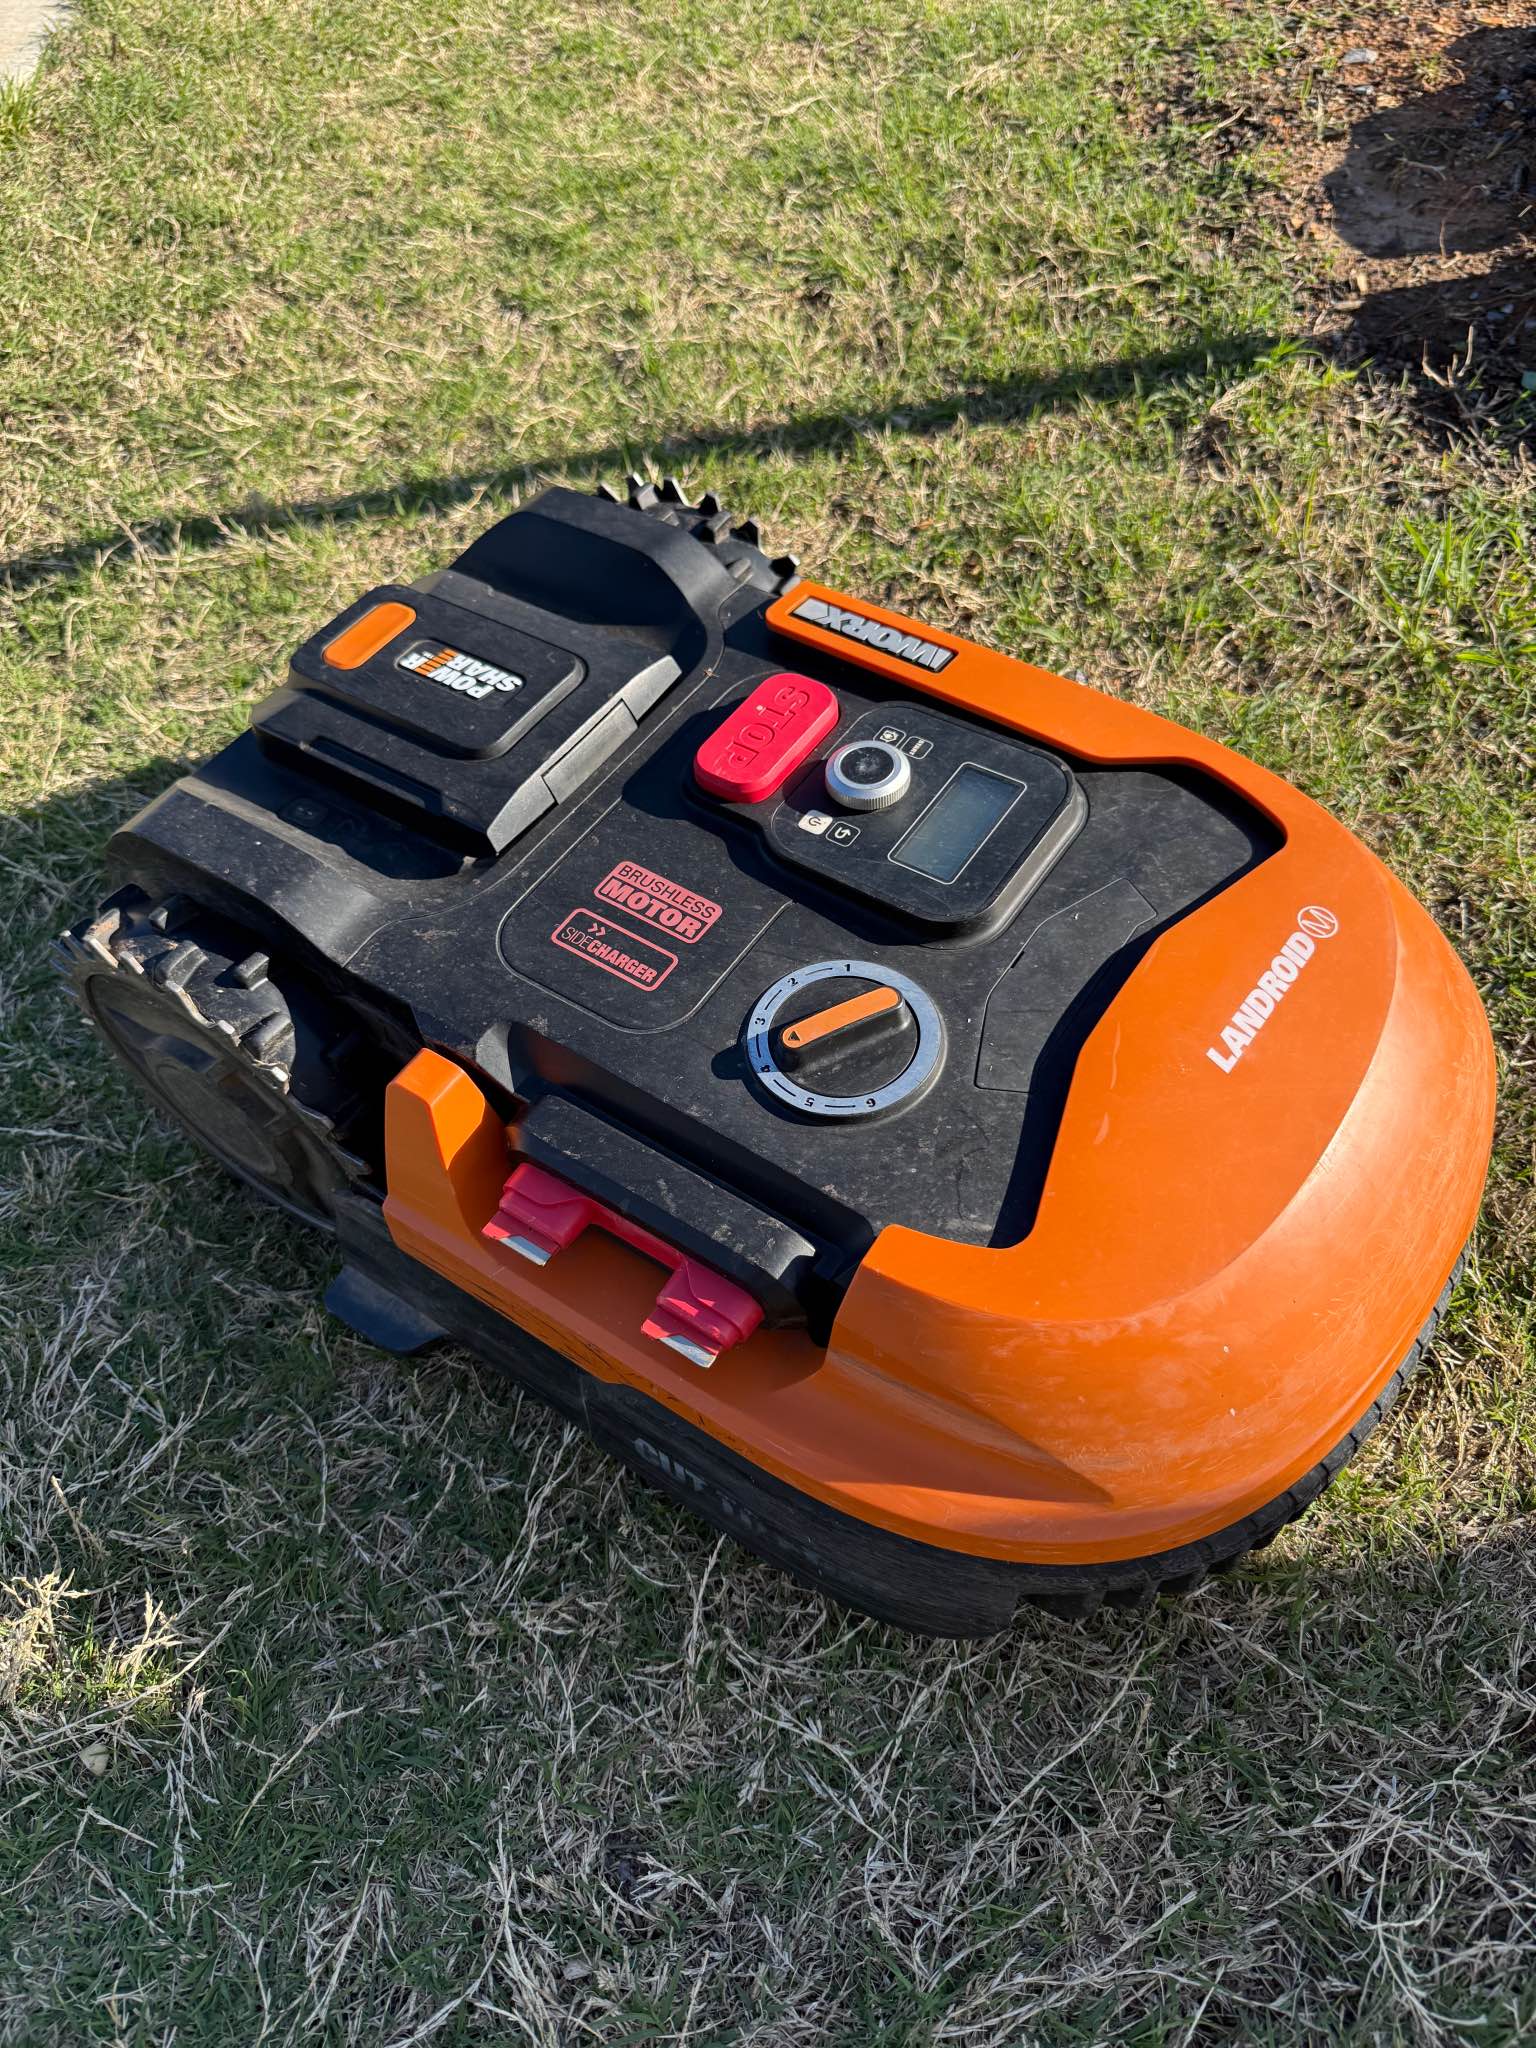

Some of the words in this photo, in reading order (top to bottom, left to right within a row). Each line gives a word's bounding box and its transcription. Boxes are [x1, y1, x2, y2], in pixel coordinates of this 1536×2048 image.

[793, 597, 953, 671] WORX
[726, 686, 810, 768] STOP
[617, 864, 716, 919] BRUSHLESS
[600, 877, 702, 939] MOTOR
[561, 926, 658, 983] SIDECHARGER
[844, 963, 851, 972] 1
[787, 977, 799, 987] 2
[1206, 931, 1316, 1075] LANDROID
[1298, 906, 1338, 938] M
[754, 1016, 766, 1026] 3
[759, 1064, 771, 1073] 4
[804, 1097, 815, 1107] 5
[866, 1098, 876, 1108] 6
